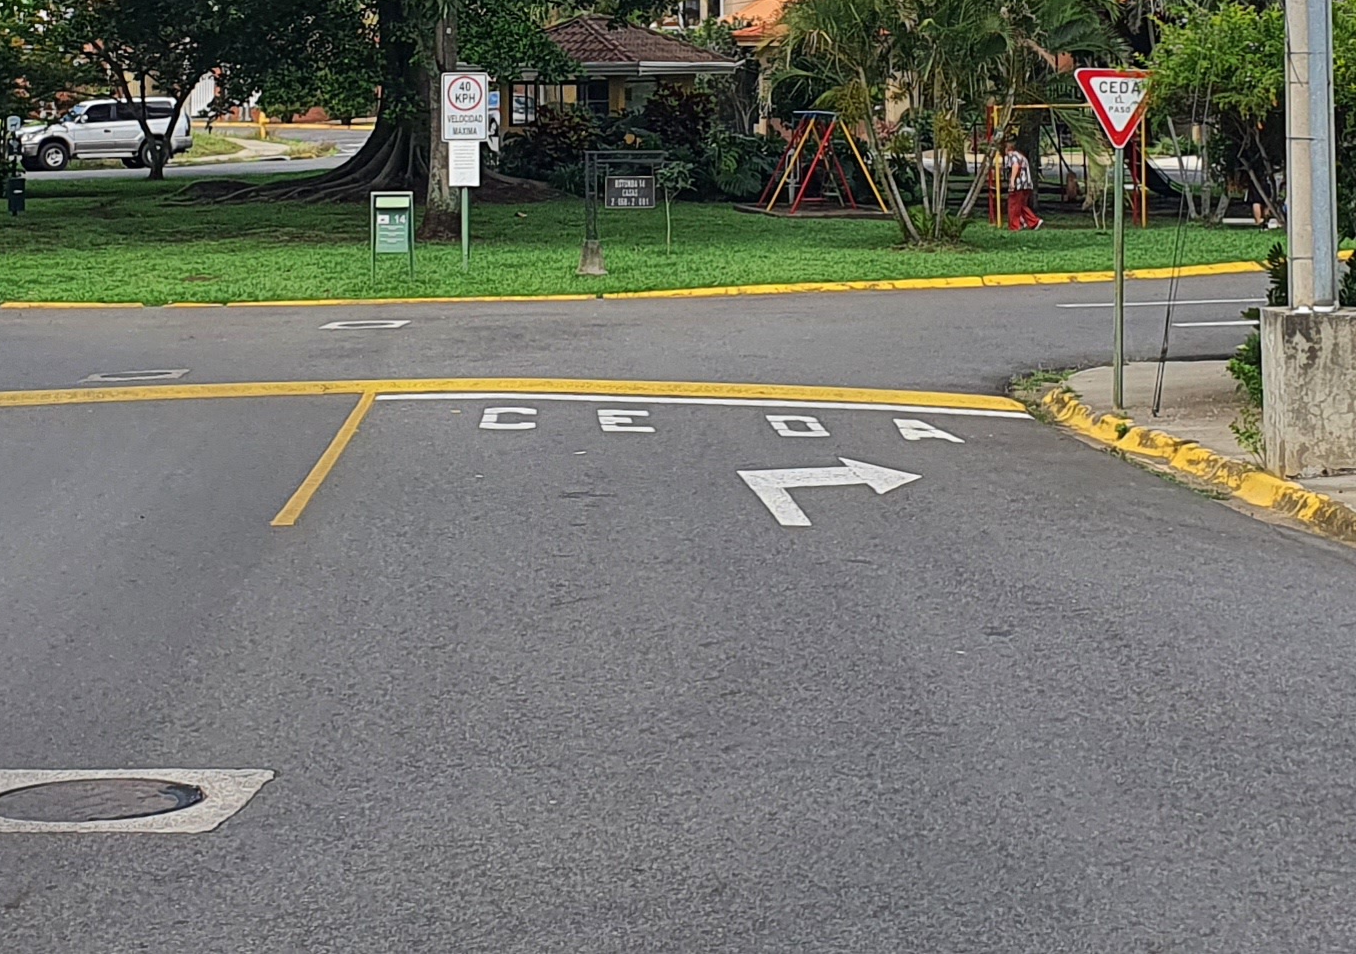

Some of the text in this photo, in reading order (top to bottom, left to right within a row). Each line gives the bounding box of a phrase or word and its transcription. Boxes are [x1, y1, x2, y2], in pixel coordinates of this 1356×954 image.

[459, 81, 472, 92] 40
[1099, 80, 1141, 94] CEDA
[455, 93, 476, 104] KPH
[447, 114, 483, 123] VELOCIDAD
[394, 214, 406, 224] 14
[479, 407, 966, 443] CEDA
